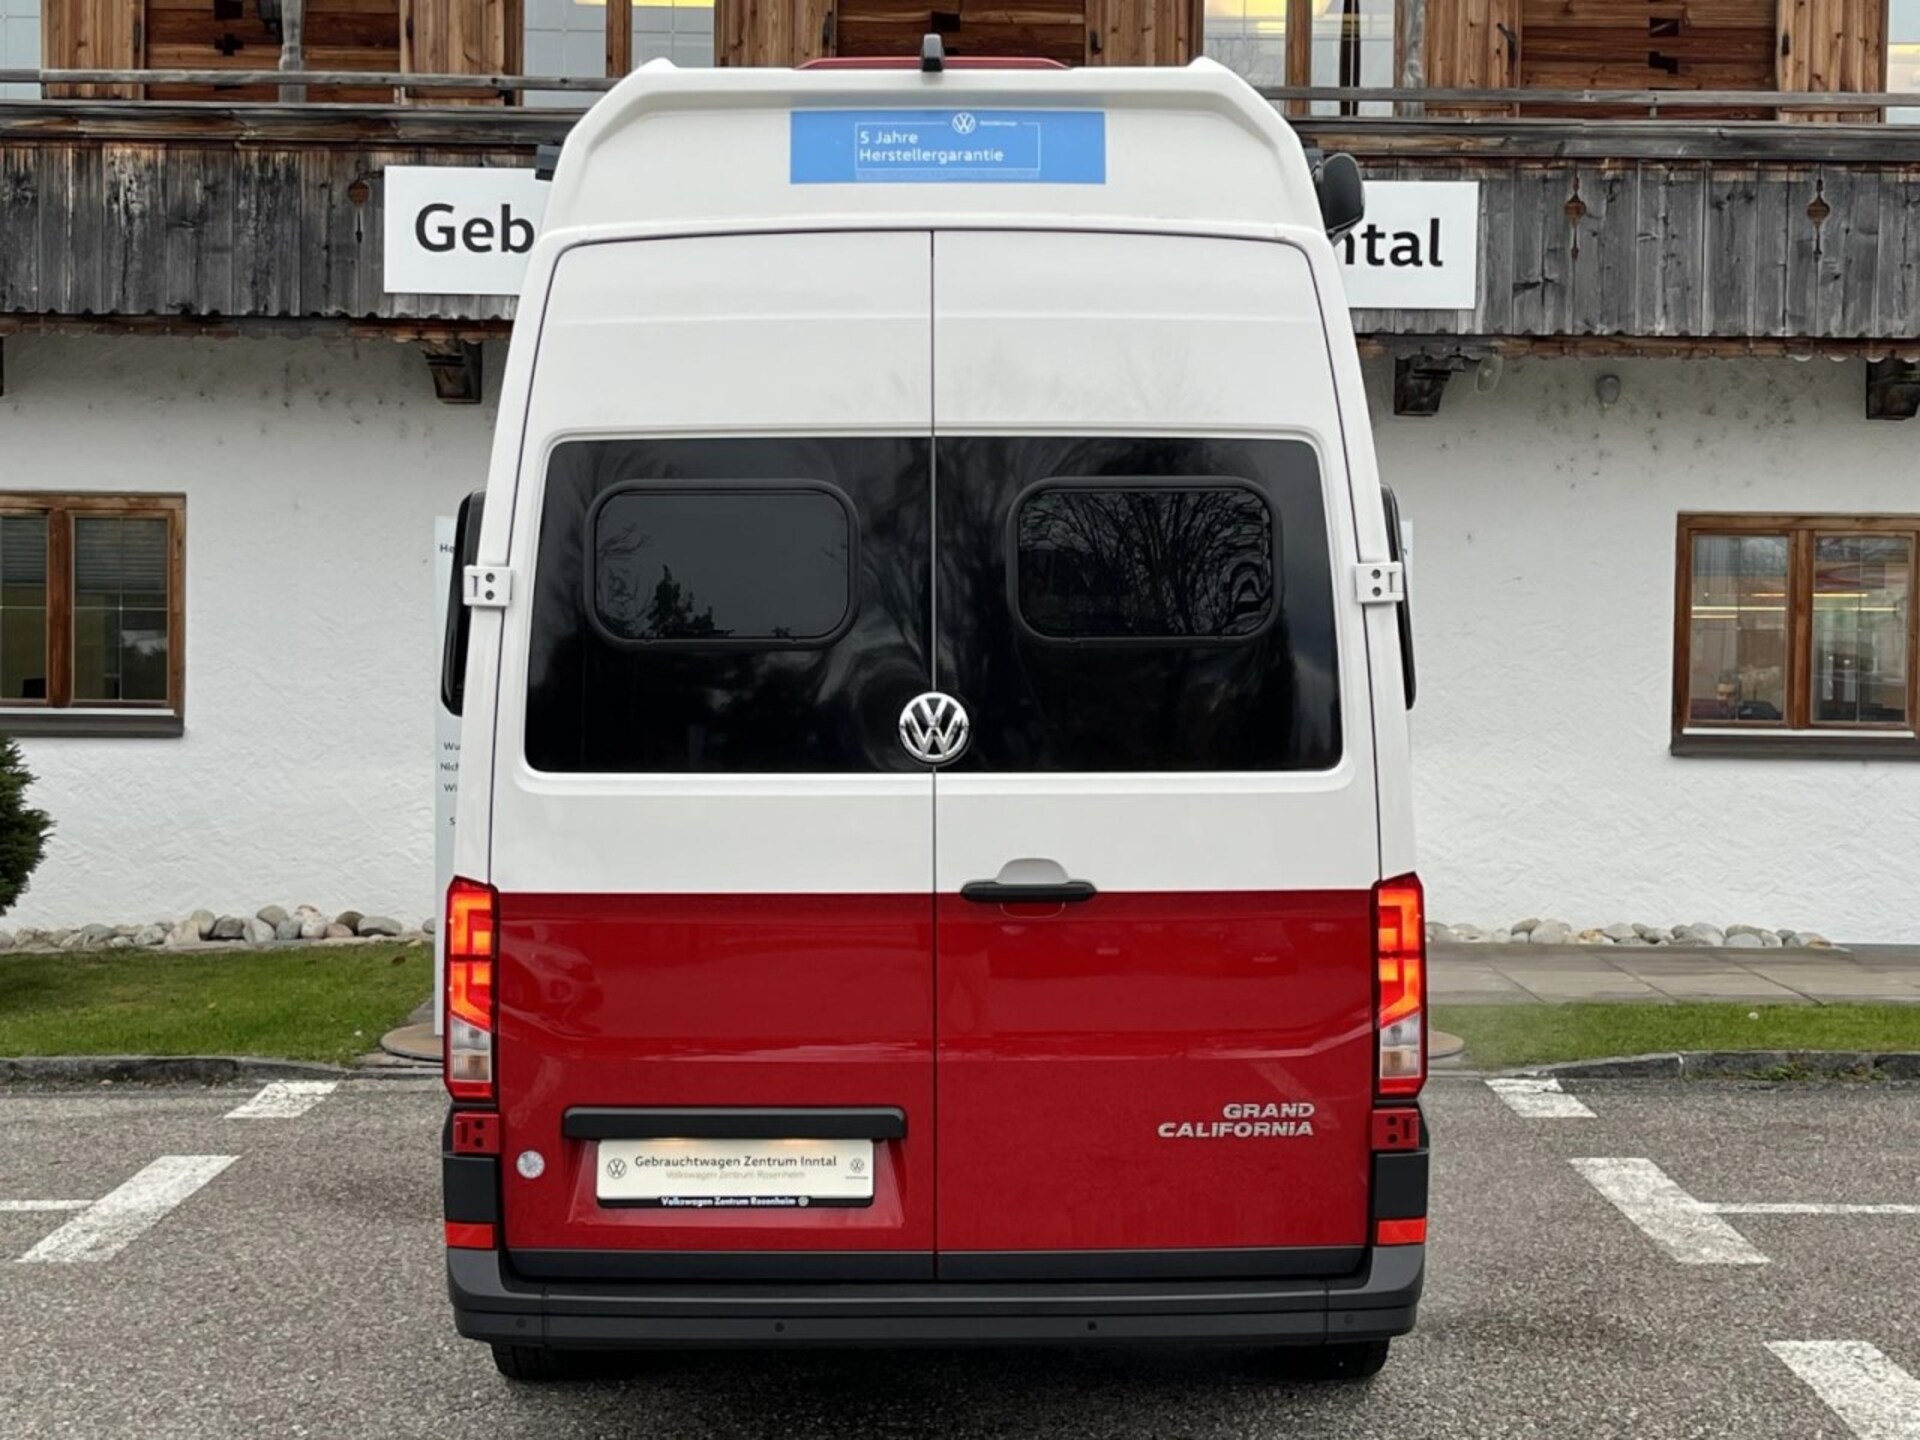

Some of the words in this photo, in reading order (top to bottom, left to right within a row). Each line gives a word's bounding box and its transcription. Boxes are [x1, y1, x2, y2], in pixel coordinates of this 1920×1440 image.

[859, 131, 869, 144] 5
[874, 131, 919, 144] Jahre
[859, 148, 1004, 165] Herstellergarantie
[1222, 1102, 1316, 1119] GRAND
[1157, 1121, 1314, 1138] CALIFORNIA
[634, 1156, 740, 1169] Gebrauchtwagen
[744, 1156, 798, 1167] Zentrum
[800, 1156, 837, 1167] Inntal
